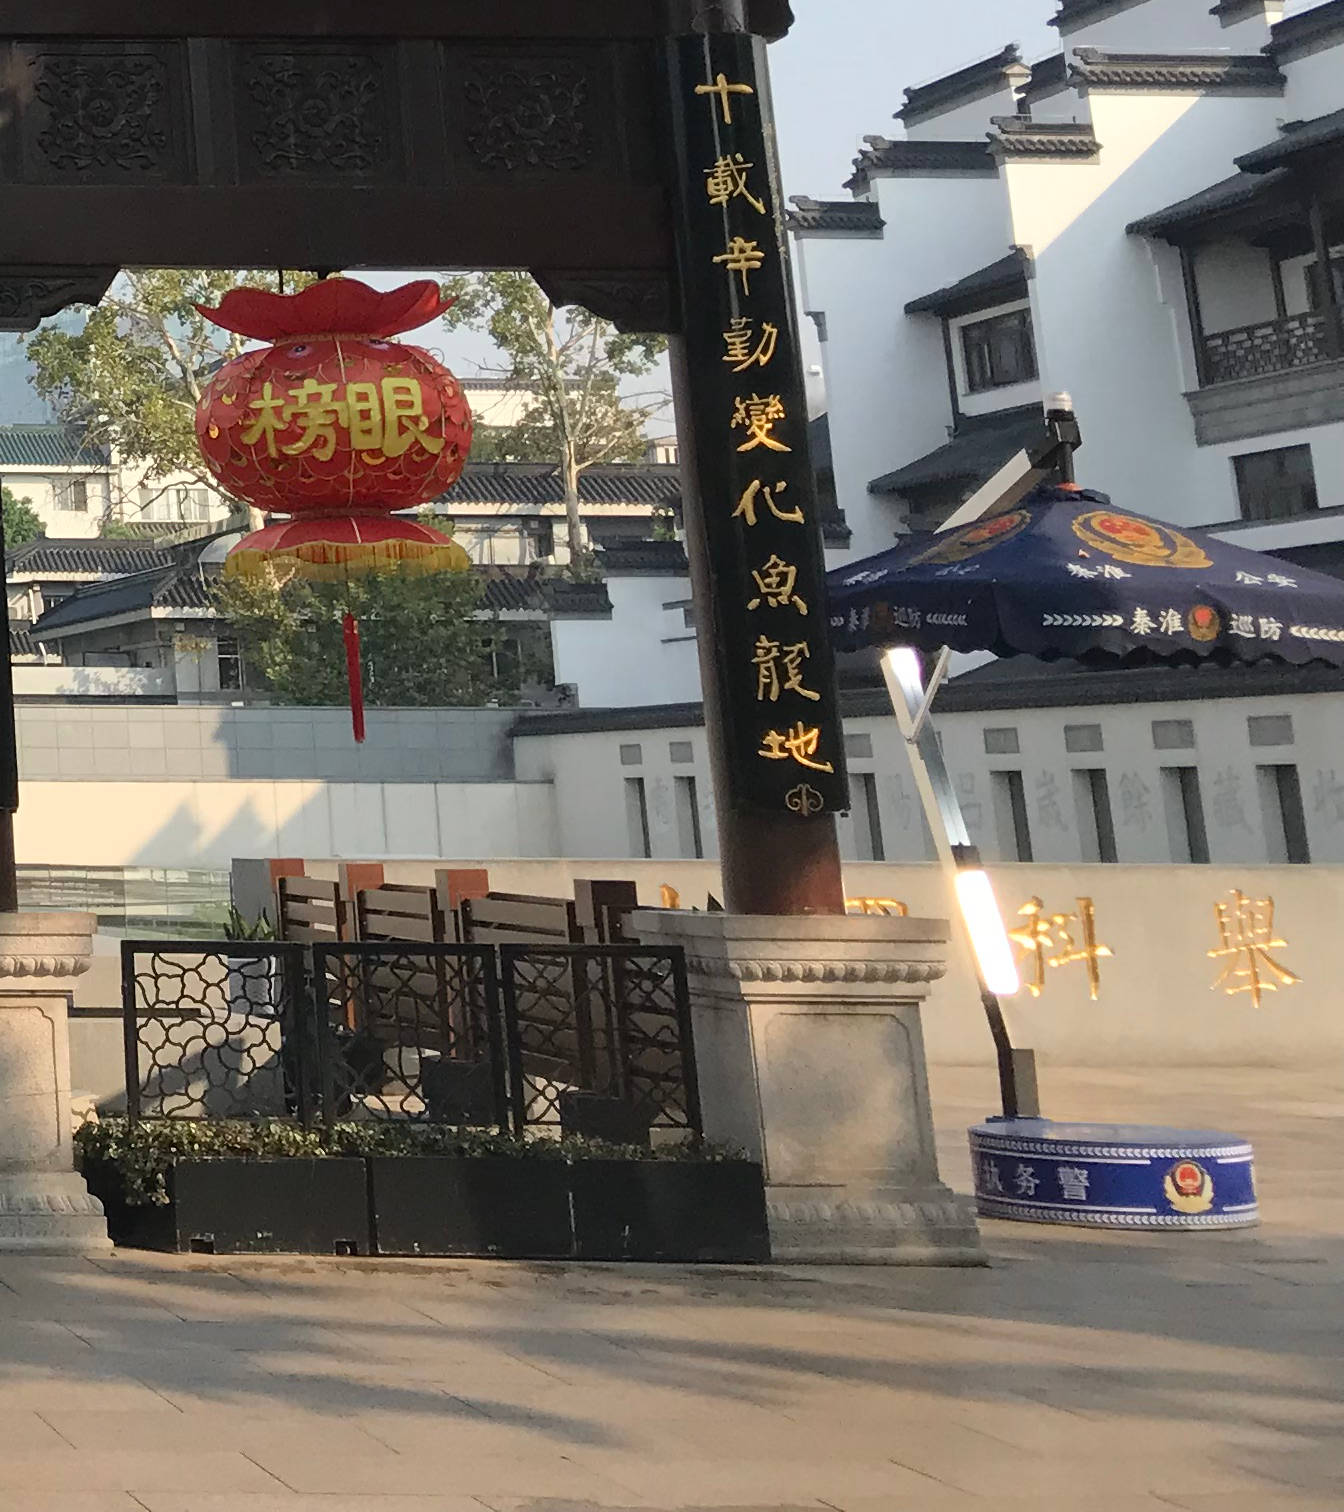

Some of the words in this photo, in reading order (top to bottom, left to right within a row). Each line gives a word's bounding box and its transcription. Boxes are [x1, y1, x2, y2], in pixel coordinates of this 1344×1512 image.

[239, 377, 445, 461] 榜眼
[1128, 606, 1185, 636] 秦淮
[1229, 611, 1284, 641] 巡防
